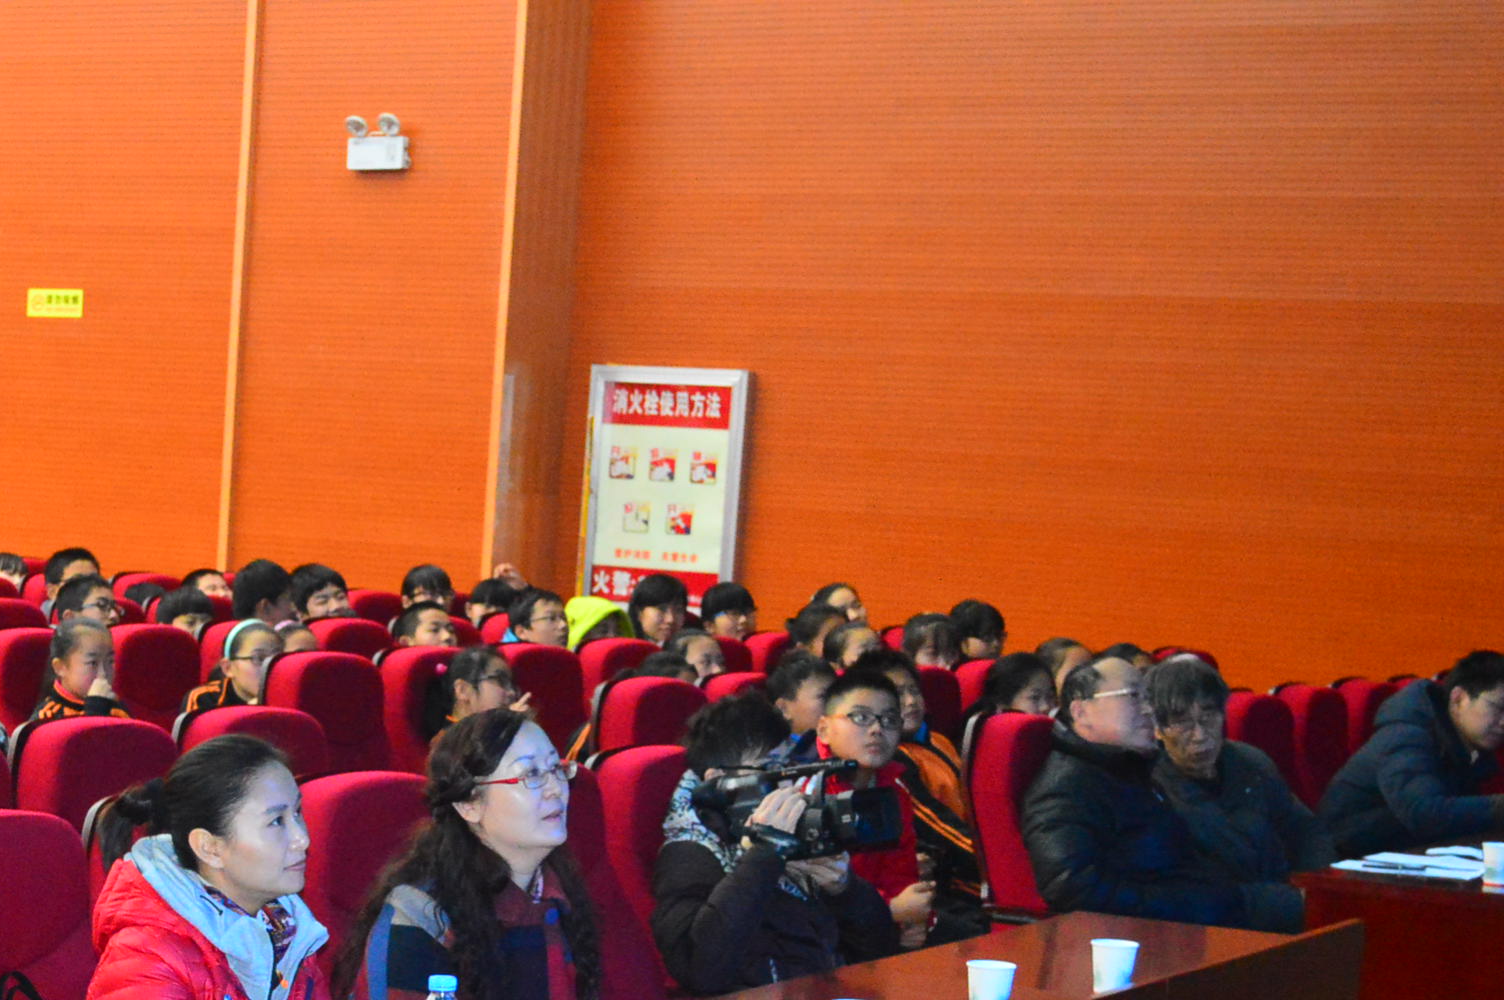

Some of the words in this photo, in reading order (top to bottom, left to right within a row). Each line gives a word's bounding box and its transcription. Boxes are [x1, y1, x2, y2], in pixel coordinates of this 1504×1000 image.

[612, 388, 721, 418] 消火栓使用方法
